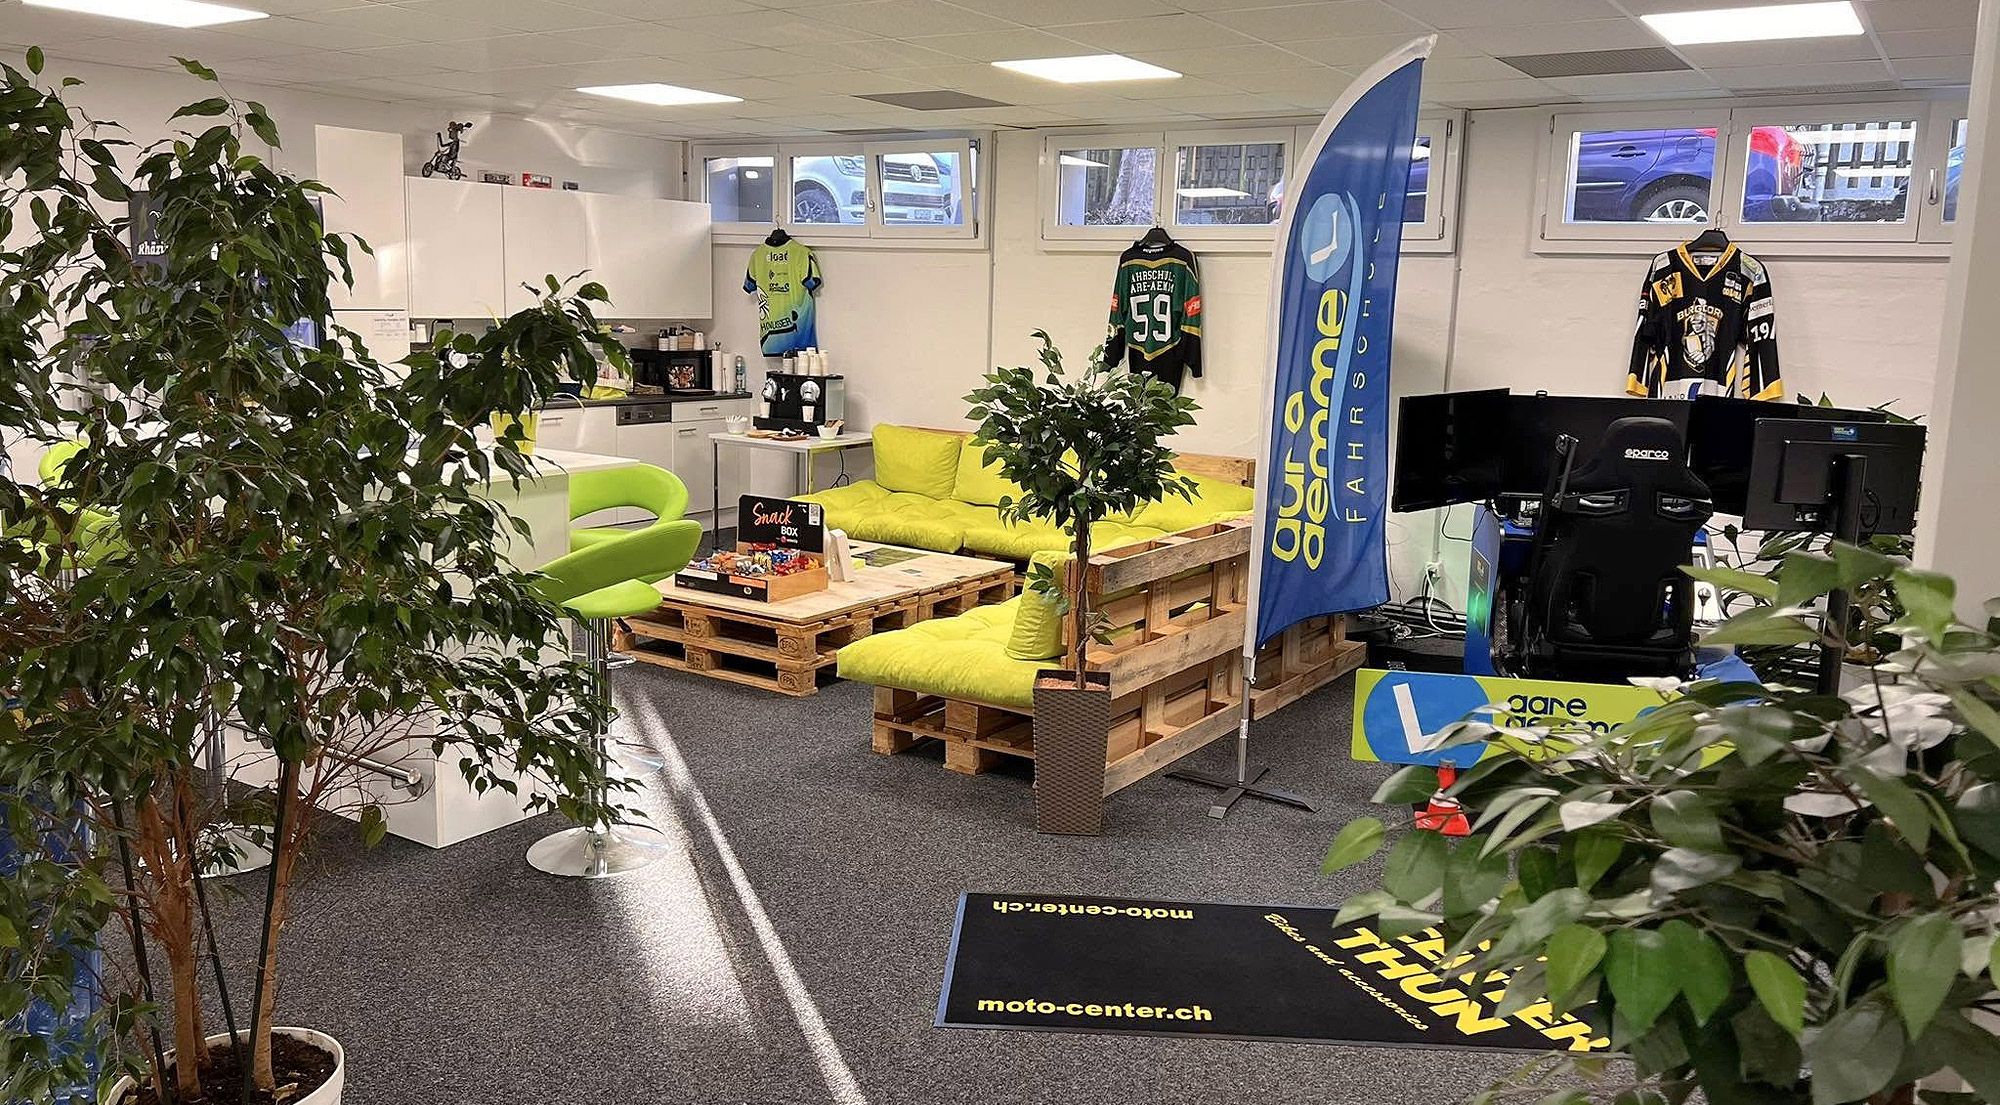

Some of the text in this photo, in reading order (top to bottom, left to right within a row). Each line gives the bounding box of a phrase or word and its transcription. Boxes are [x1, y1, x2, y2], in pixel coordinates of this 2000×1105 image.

[1130, 294, 1172, 342] 59
[1302, 288, 1348, 571] aemme
[752, 501, 793, 526] Snack
[780, 525, 798, 537] BOX
[1507, 694, 1587, 717] aare
[993, 900, 1195, 920] moto-center.ch
[1264, 913, 1430, 1032] Bikes and accessories
[1333, 926, 1510, 1036] THUN
[977, 998, 1213, 1021] moto-center.ch
